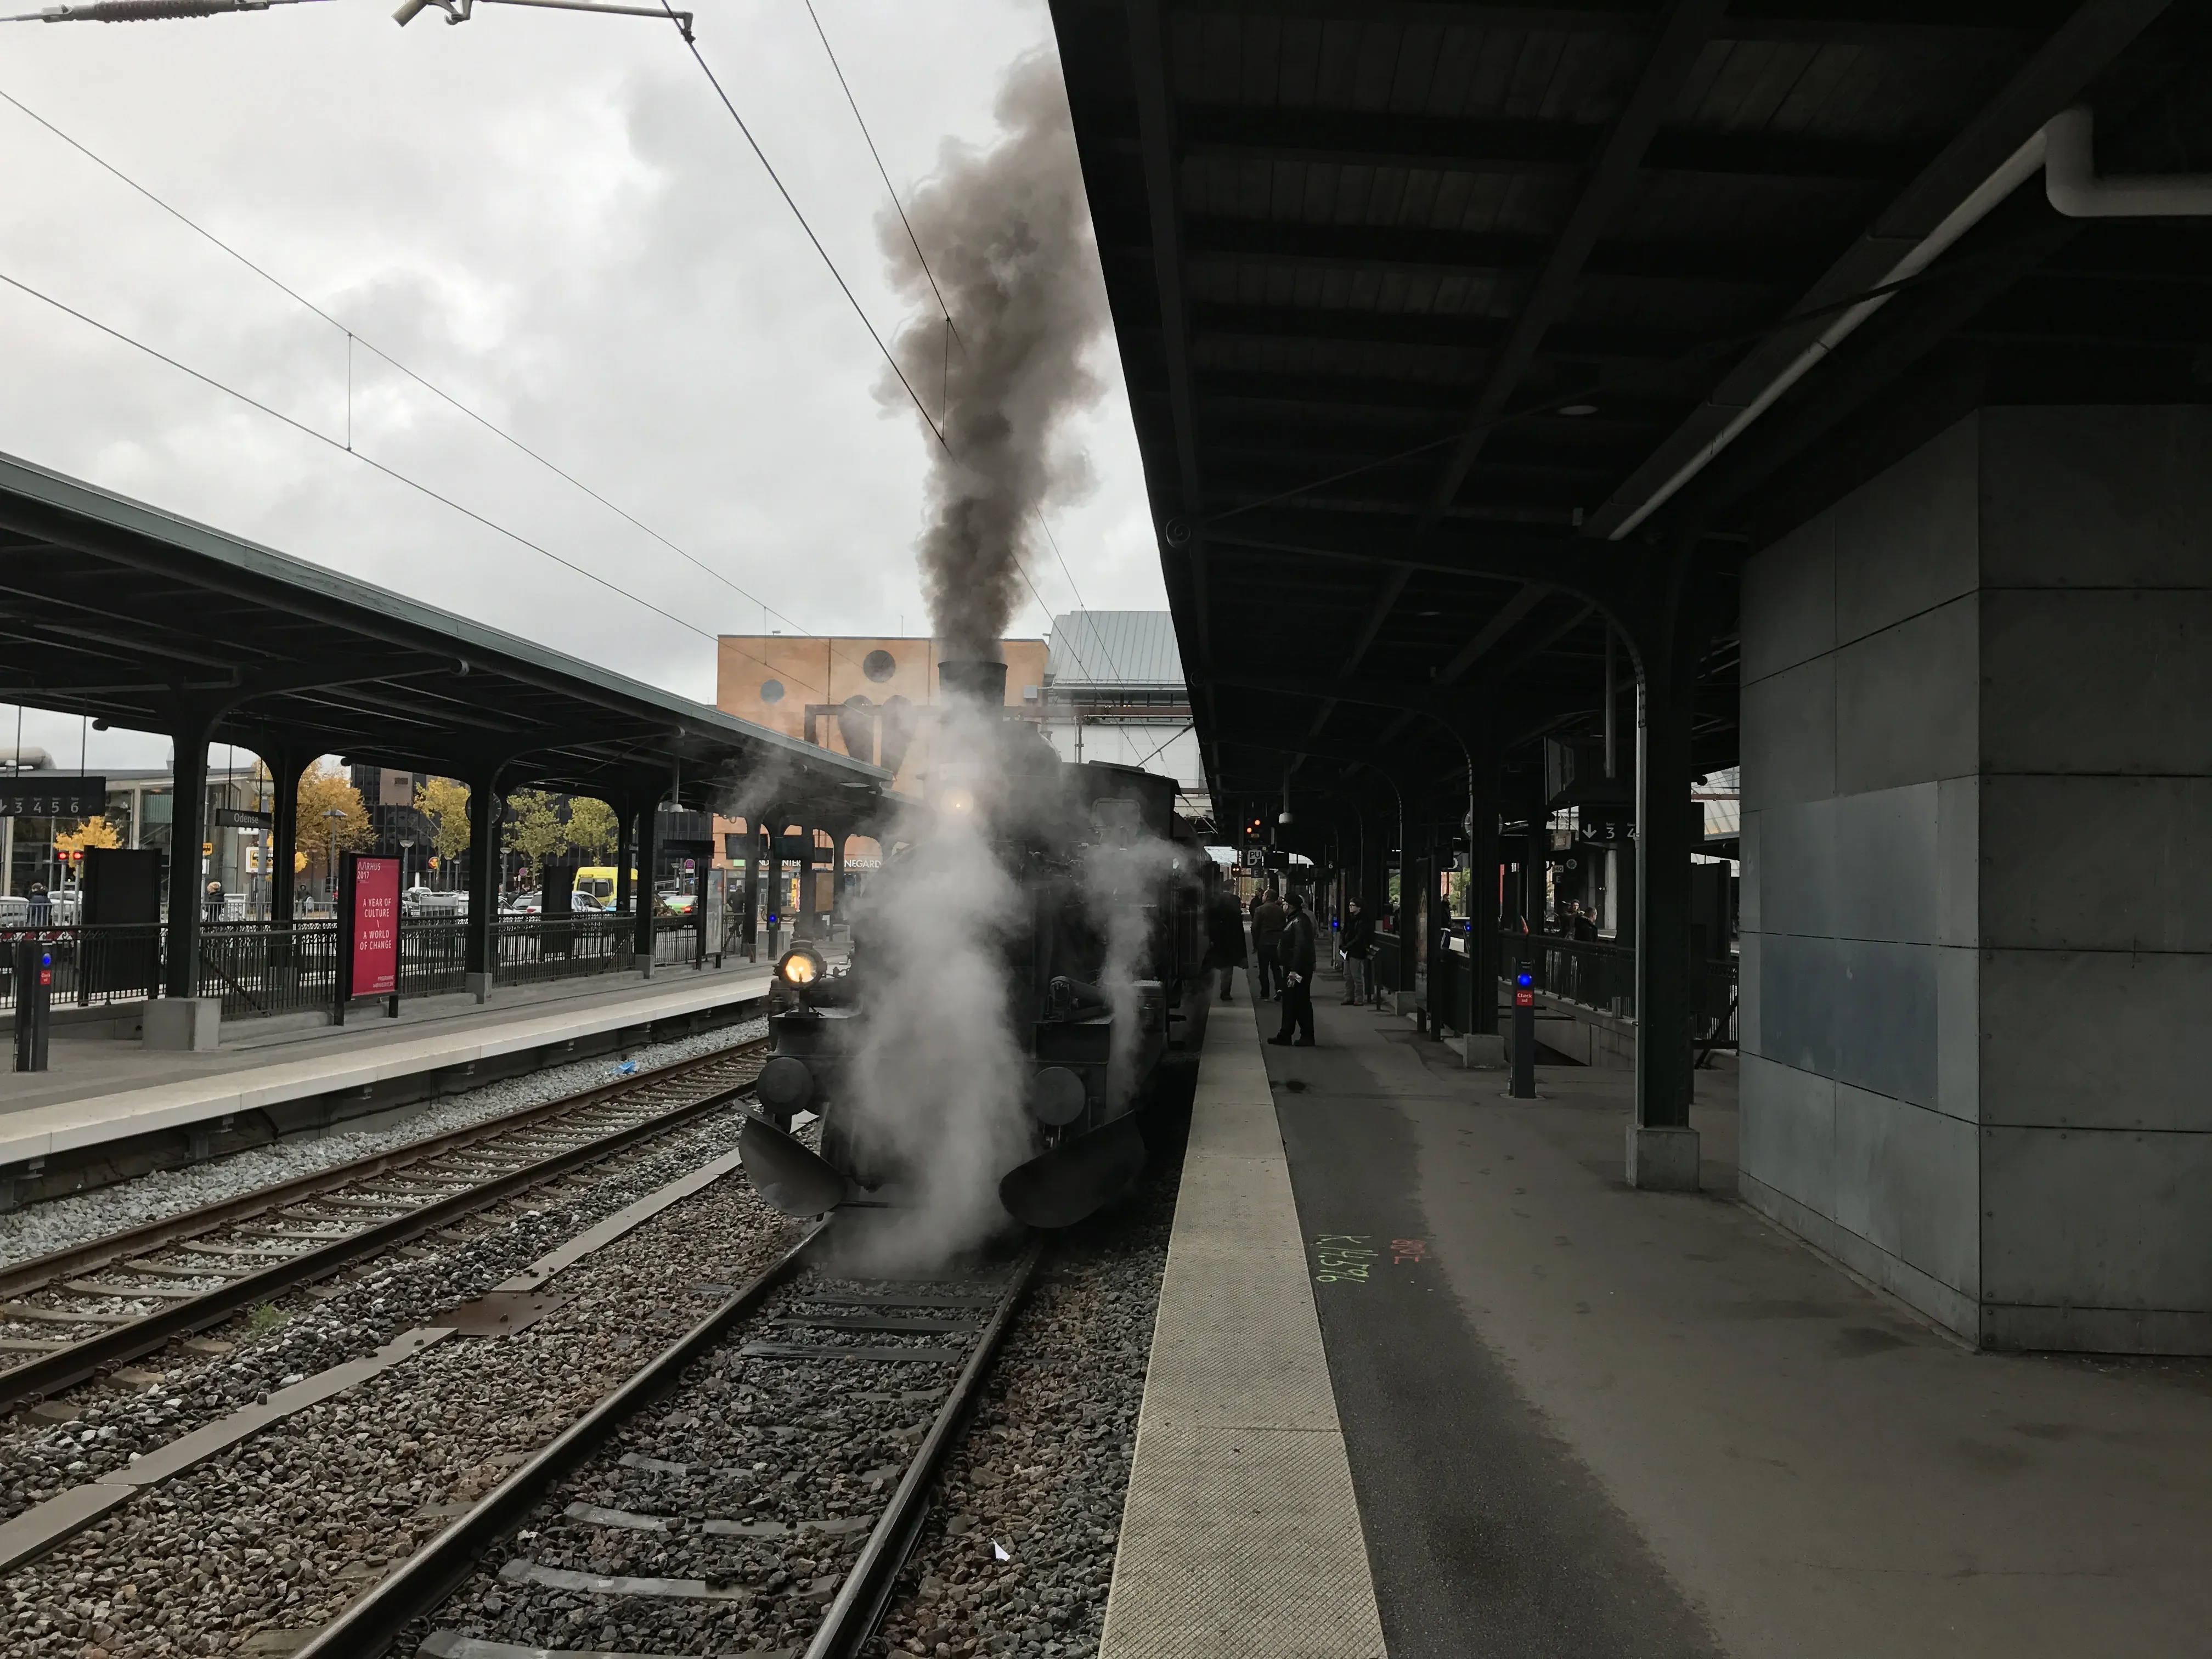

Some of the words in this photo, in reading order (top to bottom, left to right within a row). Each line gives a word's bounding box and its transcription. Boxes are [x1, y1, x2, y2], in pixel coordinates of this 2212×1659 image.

[15, 802, 22, 814] 3
[33, 802, 42, 813] 4
[52, 802, 59, 813] 5
[70, 802, 79, 813] 6
[234, 812, 259, 824] Odense
[1606, 827, 1615, 839] 3
[1627, 828, 1635, 839] 4
[357, 861, 381, 871] AARHUS
[844, 858, 881, 868] NEGÅRD
[357, 871, 369, 879] 2017
[363, 899, 366, 907] A
[368, 898, 382, 907] YEAR
[384, 898, 391, 907] OF
[364, 909, 389, 918] CULTURE
[363, 931, 367, 939] A
[369, 929, 390, 939] WORLD
[360, 941, 368, 951] OF
[369, 940, 391, 950] CHANGE
